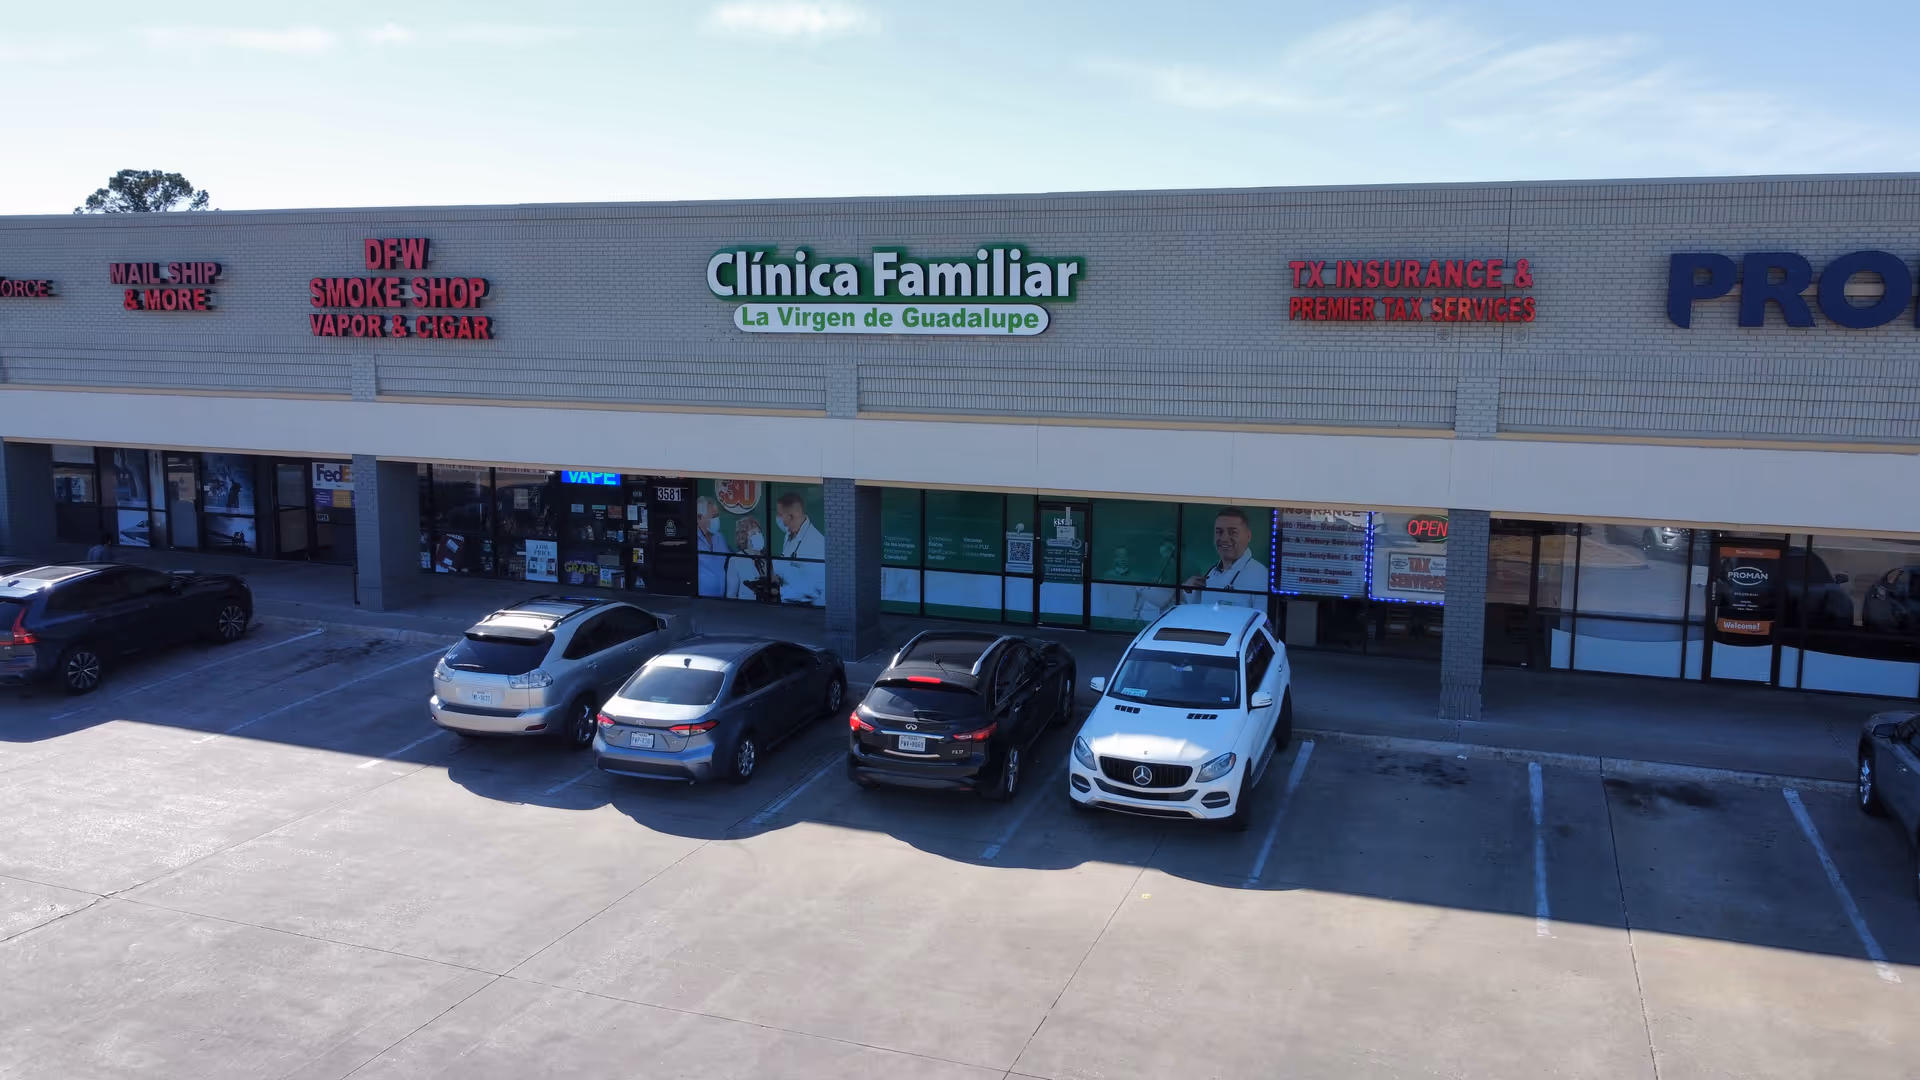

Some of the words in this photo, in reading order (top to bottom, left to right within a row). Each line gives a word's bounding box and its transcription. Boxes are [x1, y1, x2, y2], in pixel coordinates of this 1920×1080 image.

[365, 238, 427, 270] DFW
[110, 262, 161, 285] MAIL
[168, 262, 218, 285] SHIP
[707, 251, 859, 297] Clínica
[873, 248, 1078, 297] Familiar
[1289, 260, 1326, 288] TX
[1336, 259, 1503, 288] INSURANCE
[1514, 258, 1534, 288] &
[0, 279, 49, 297] ORCE
[309, 277, 404, 308] SMOKE
[411, 277, 487, 309] SHOP
[1667, 250, 1920, 330] PRO
[123, 289, 139, 311] &
[144, 289, 208, 311] MORE
[1289, 296, 1375, 321] PREMIER
[1382, 296, 1423, 321] TAX
[1430, 296, 1536, 323] SERVICES
[309, 314, 384, 337] VAPOR
[391, 314, 408, 338] &
[416, 315, 490, 340] CIGAR
[742, 307, 769, 326] La
[777, 307, 855, 332] Virgen
[863, 307, 893, 328] de
[902, 307, 1039, 333] Guadalupe
[316, 464, 352, 483] FedE
[568, 471, 617, 485] VAPE
[658, 487, 680, 501] 3581
[1407, 519, 1448, 537] OPEN
[564, 560, 599, 576] GRAPE
[1408, 557, 1431, 573] TAX
[1727, 571, 1768, 580] PROMAN
[1723, 621, 1760, 631] Welcome!
